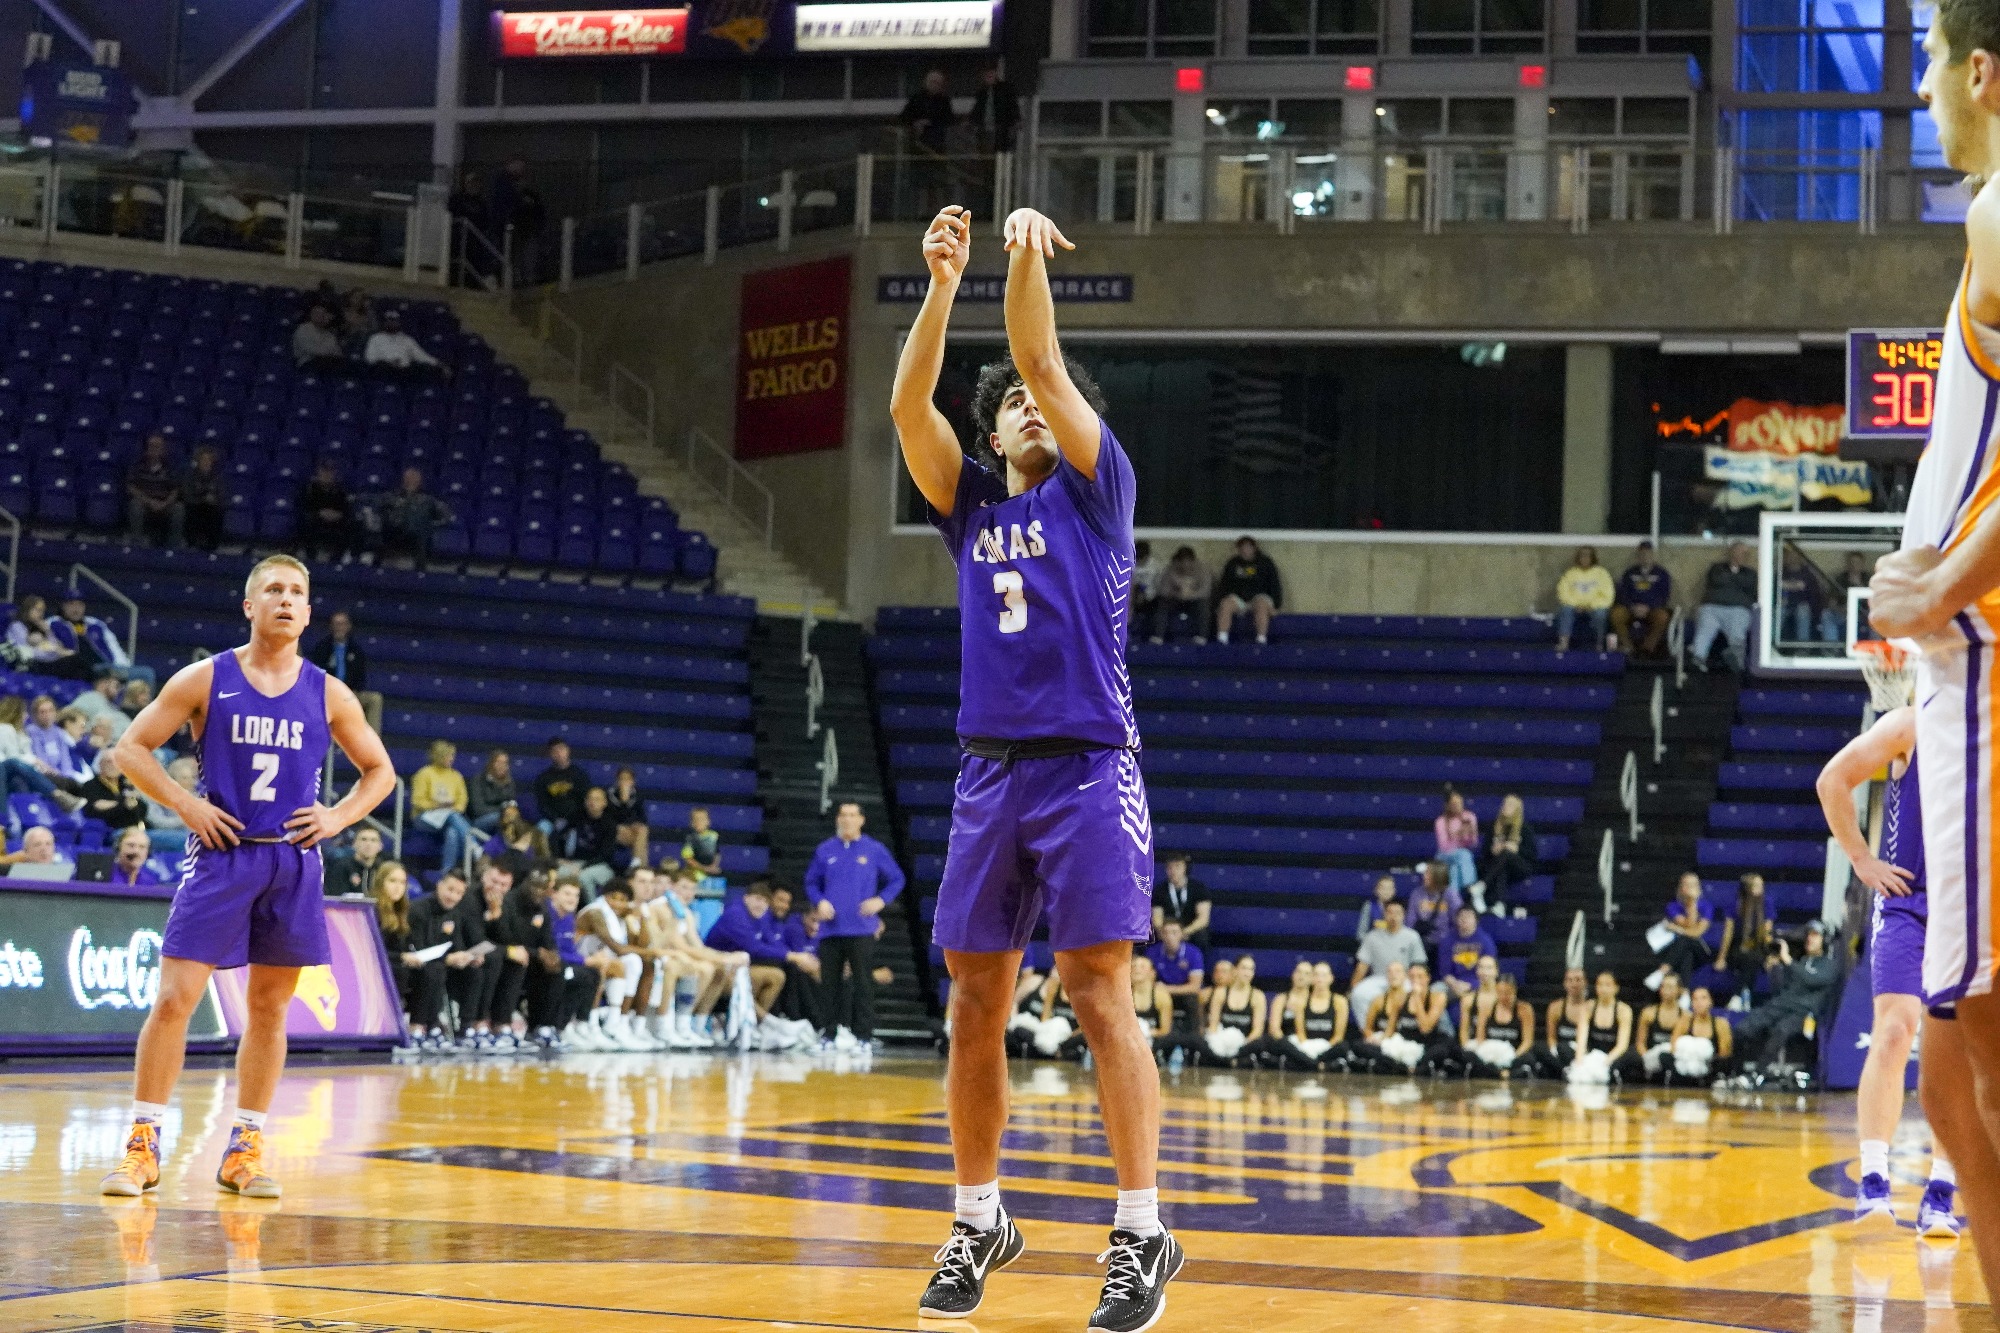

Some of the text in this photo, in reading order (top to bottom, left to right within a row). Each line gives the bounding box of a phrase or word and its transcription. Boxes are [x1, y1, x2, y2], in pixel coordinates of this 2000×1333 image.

[535, 15, 608, 49] Other
[611, 13, 674, 46] Place
[745, 317, 839, 359] WELLS
[1878, 340, 1943, 369] 4:42
[745, 358, 838, 400] FARGO
[1872, 373, 1933, 426] 30
[993, 570, 1028, 634] 3
[231, 713, 305, 750] LORAS
[249, 752, 281, 802] 2
